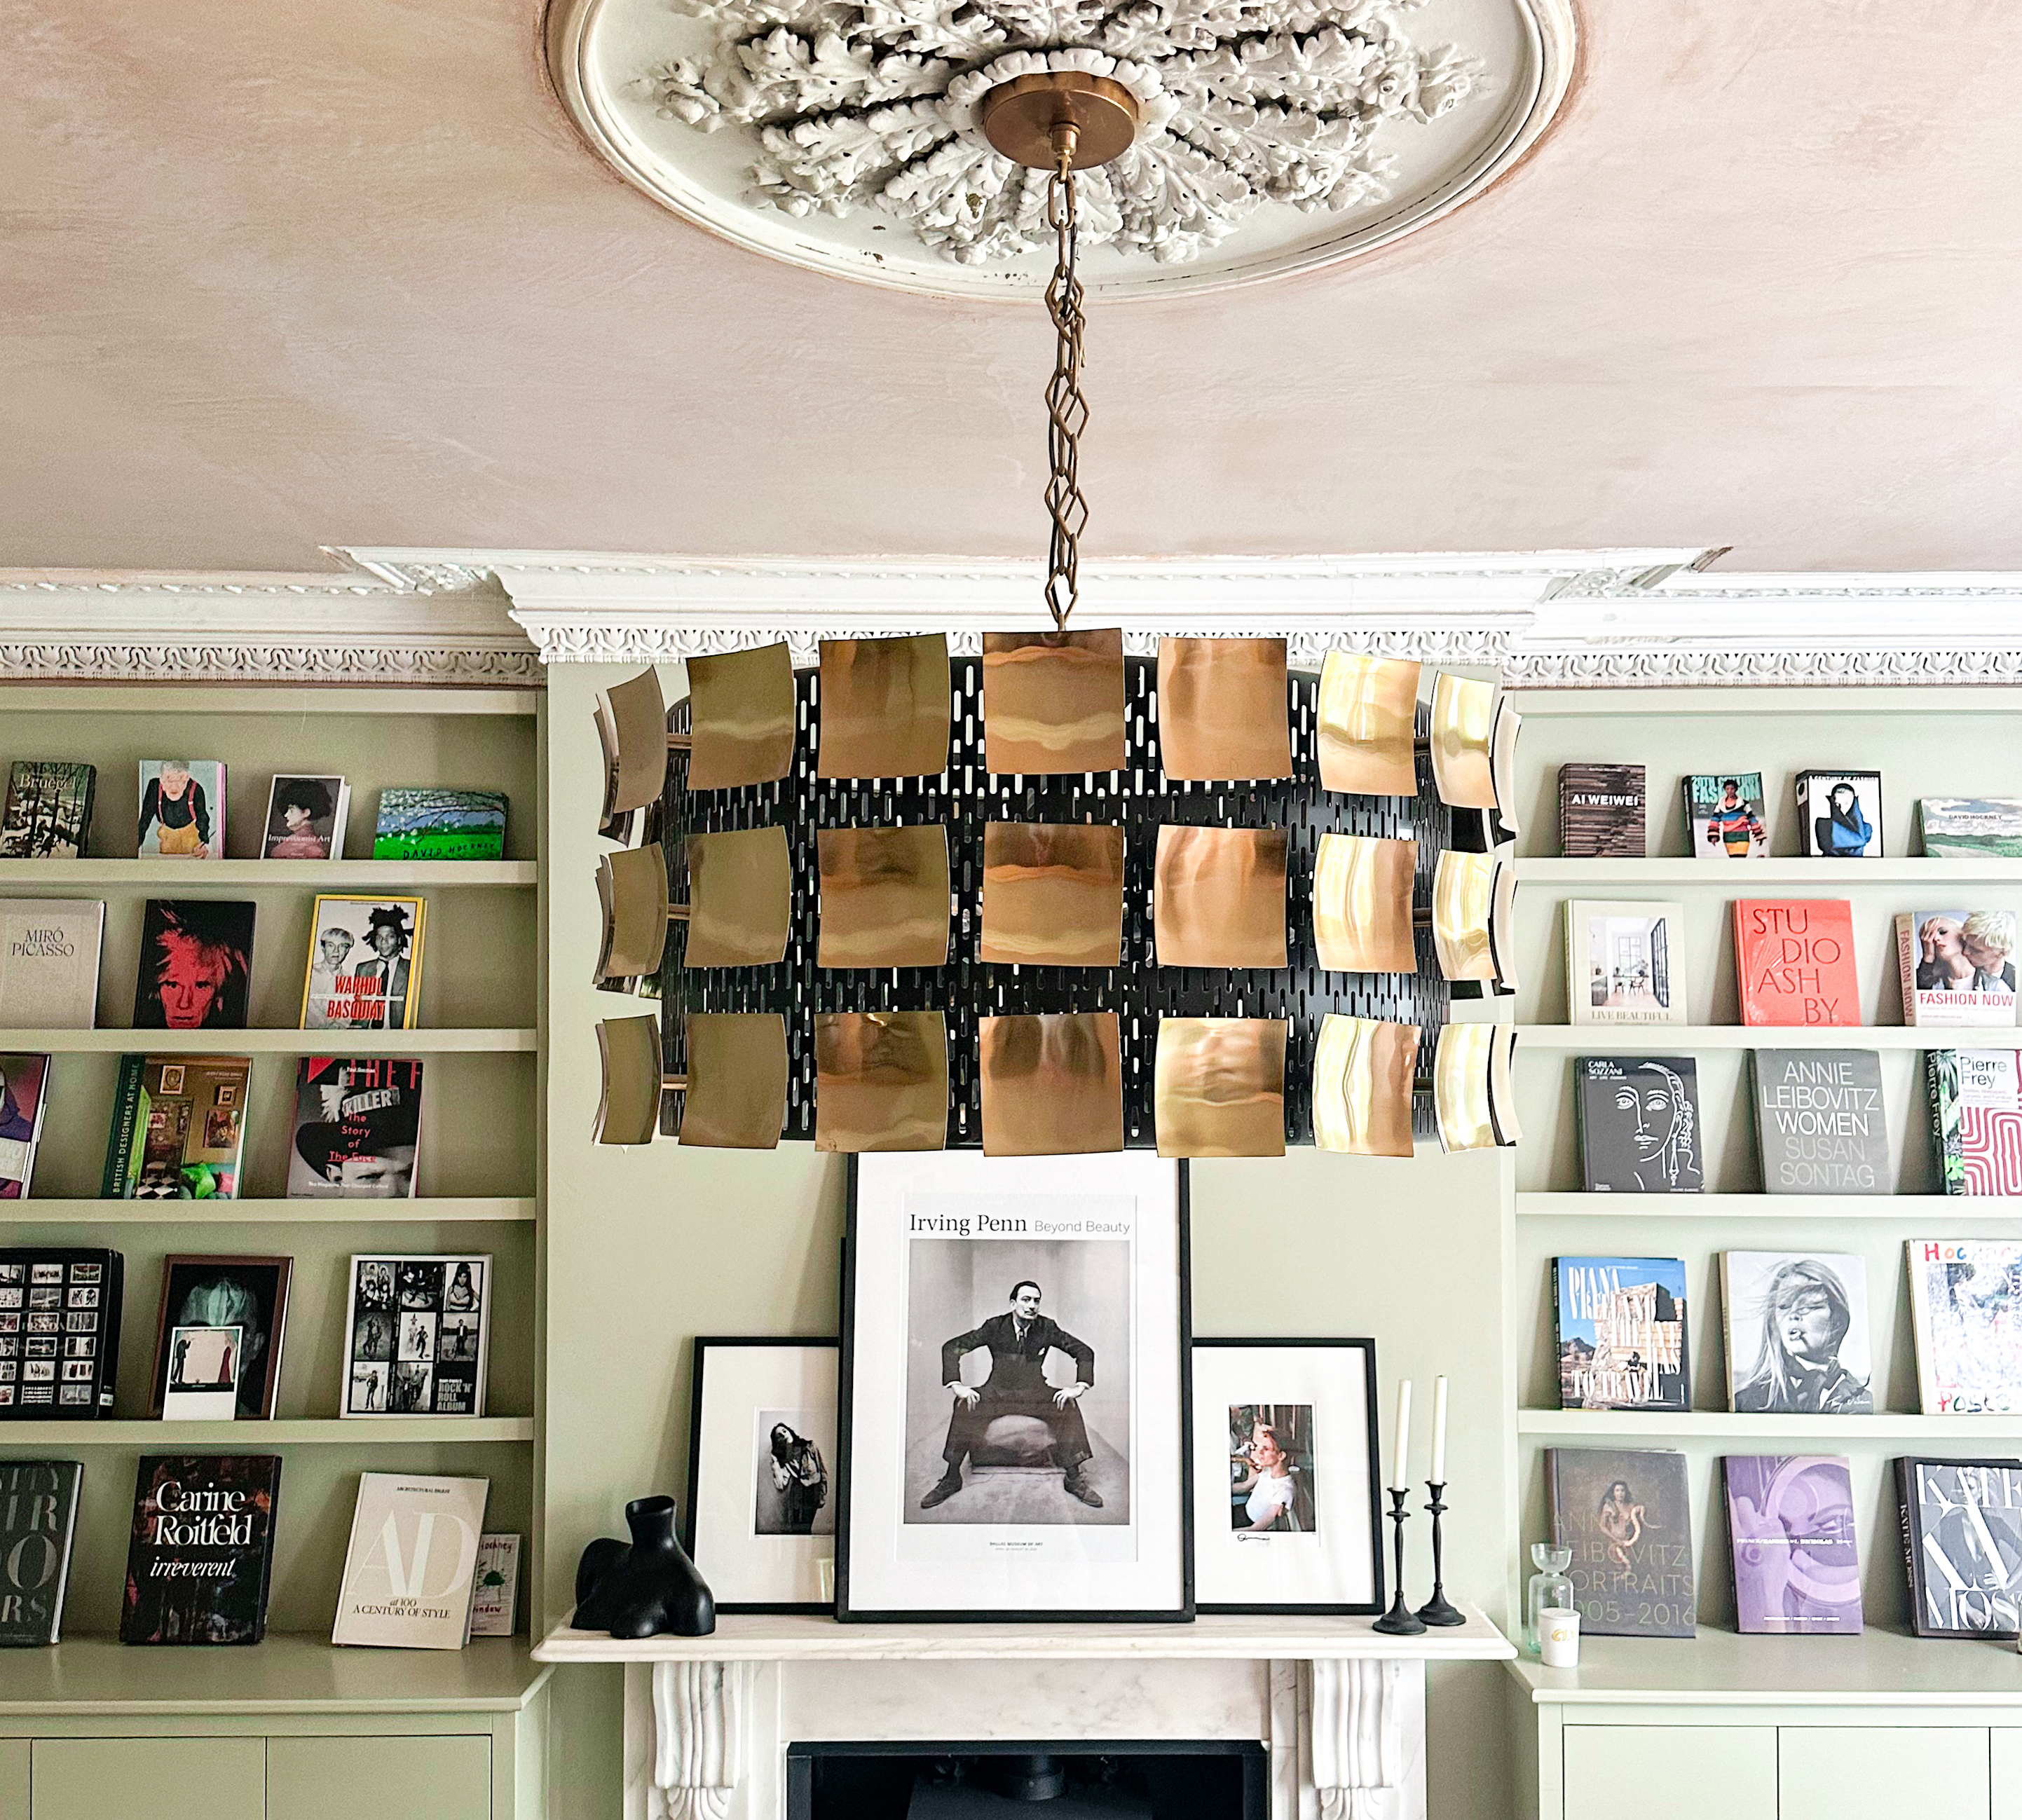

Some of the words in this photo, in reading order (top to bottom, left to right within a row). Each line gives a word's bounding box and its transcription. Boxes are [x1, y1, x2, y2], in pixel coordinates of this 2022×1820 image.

[20, 774, 78, 793] Bruegel
[1571, 794, 1586, 805] AI
[1587, 794, 1639, 807] WEIWEI
[268, 833, 317, 844] Impressionist
[317, 835, 331, 843] Art
[402, 847, 442, 861] DAVID
[1753, 908, 1808, 935] STU
[25, 926, 64, 943] MIRÓ
[11, 942, 75, 957] PICASSO
[1782, 938, 1841, 965] DIO
[1900, 929, 1912, 983] FASHION
[335, 976, 383, 996] WARHOL
[1757, 968, 1821, 994] ASH
[327, 999, 385, 1021] BASQUIAT
[1803, 997, 1839, 1024] BY
[1904, 987, 1913, 1017] NOW
[1920, 992, 1977, 1006] FASHION
[1982, 994, 2014, 1007] NOW
[1591, 1011, 1614, 1021] LIVE
[1587, 1060, 1615, 1069] CARLA
[1588, 1067, 1623, 1076] SOZZANI
[1783, 1060, 1854, 1086] ANNIE
[1960, 1056, 2007, 1073] Pierre
[128, 1062, 140, 1090] HOME
[1927, 1052, 1939, 1100] Pierre
[1961, 1070, 1996, 1089] Frey
[126, 1091, 135, 1102] AT
[345, 1089, 393, 1116] KILLER
[1762, 1085, 1880, 1111] LEIBOVITZ
[348, 1111, 367, 1123] The
[1775, 1110, 1869, 1137] WOMEN
[1932, 1103, 1941, 1137] Frey
[118, 1104, 133, 1155] DESIGNERS
[341, 1125, 371, 1137] Story
[348, 1139, 362, 1149] of
[1785, 1136, 1866, 1162] SUSAN
[328, 1150, 348, 1162] The
[112, 1158, 125, 1193] BRITISH
[1780, 1161, 1876, 1189] SONTAG
[909, 1214, 971, 1236] Irving
[976, 1214, 1028, 1232] Penn
[1034, 1220, 1082, 1235] Beyond
[1085, 1220, 1130, 1235] Beauty
[437, 1392, 458, 1402] ROLL
[438, 1382, 462, 1393] ROCK
[437, 1401, 466, 1411] ALBUM
[156, 1481, 246, 1512] Carine
[153, 1513, 254, 1546] Roitfeld
[344, 1509, 480, 1599] AD
[1566, 1540, 1687, 1568] EIBOVITZ
[149, 1556, 238, 1578] irreverent
[1567, 1569, 1695, 1597] ORTRAITS
[353, 1604, 360, 1614] A
[362, 1604, 406, 1617] CENTURY
[421, 1608, 451, 1620] STYLE
[389, 1599, 399, 1607] at
[400, 1598, 417, 1608] 100
